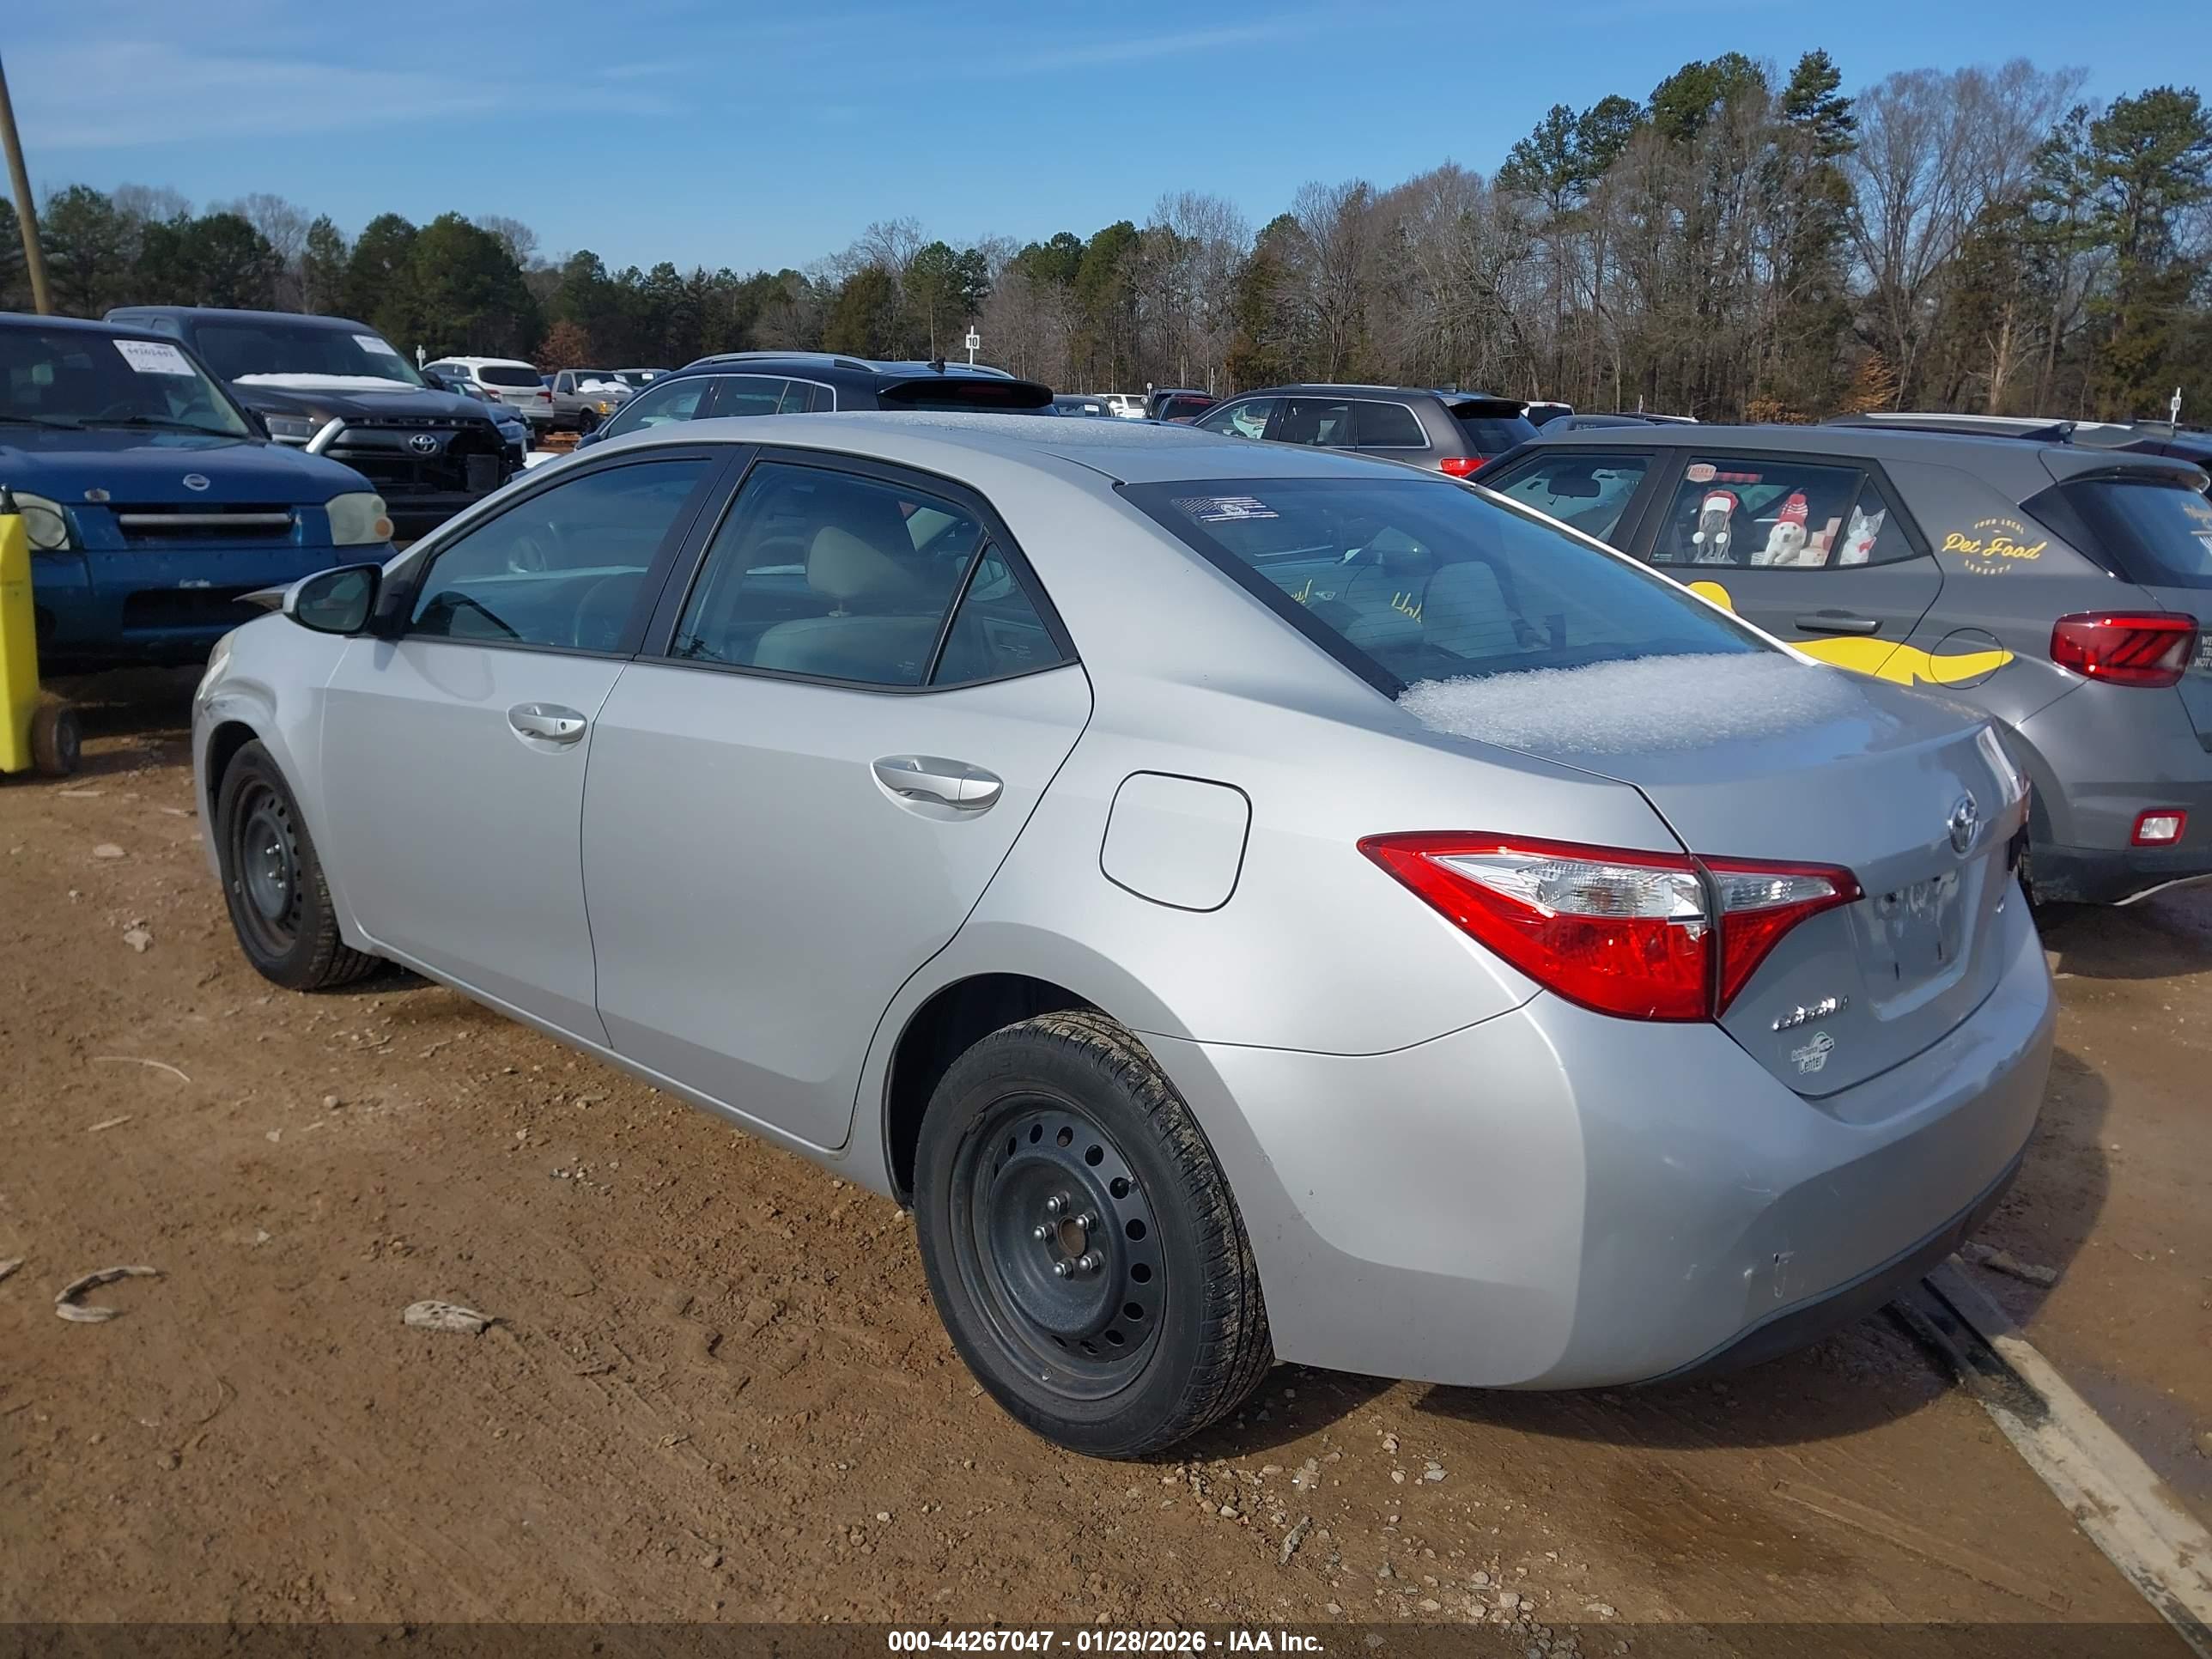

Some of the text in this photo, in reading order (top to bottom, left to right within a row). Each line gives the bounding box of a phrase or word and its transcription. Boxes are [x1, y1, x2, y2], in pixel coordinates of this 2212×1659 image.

[969, 336, 978, 348] 10
[1974, 518, 2025, 535] YOUR LOCAL
[1942, 532, 2048, 560] Pet Food
[1964, 559, 2012, 575] EXPERTS
